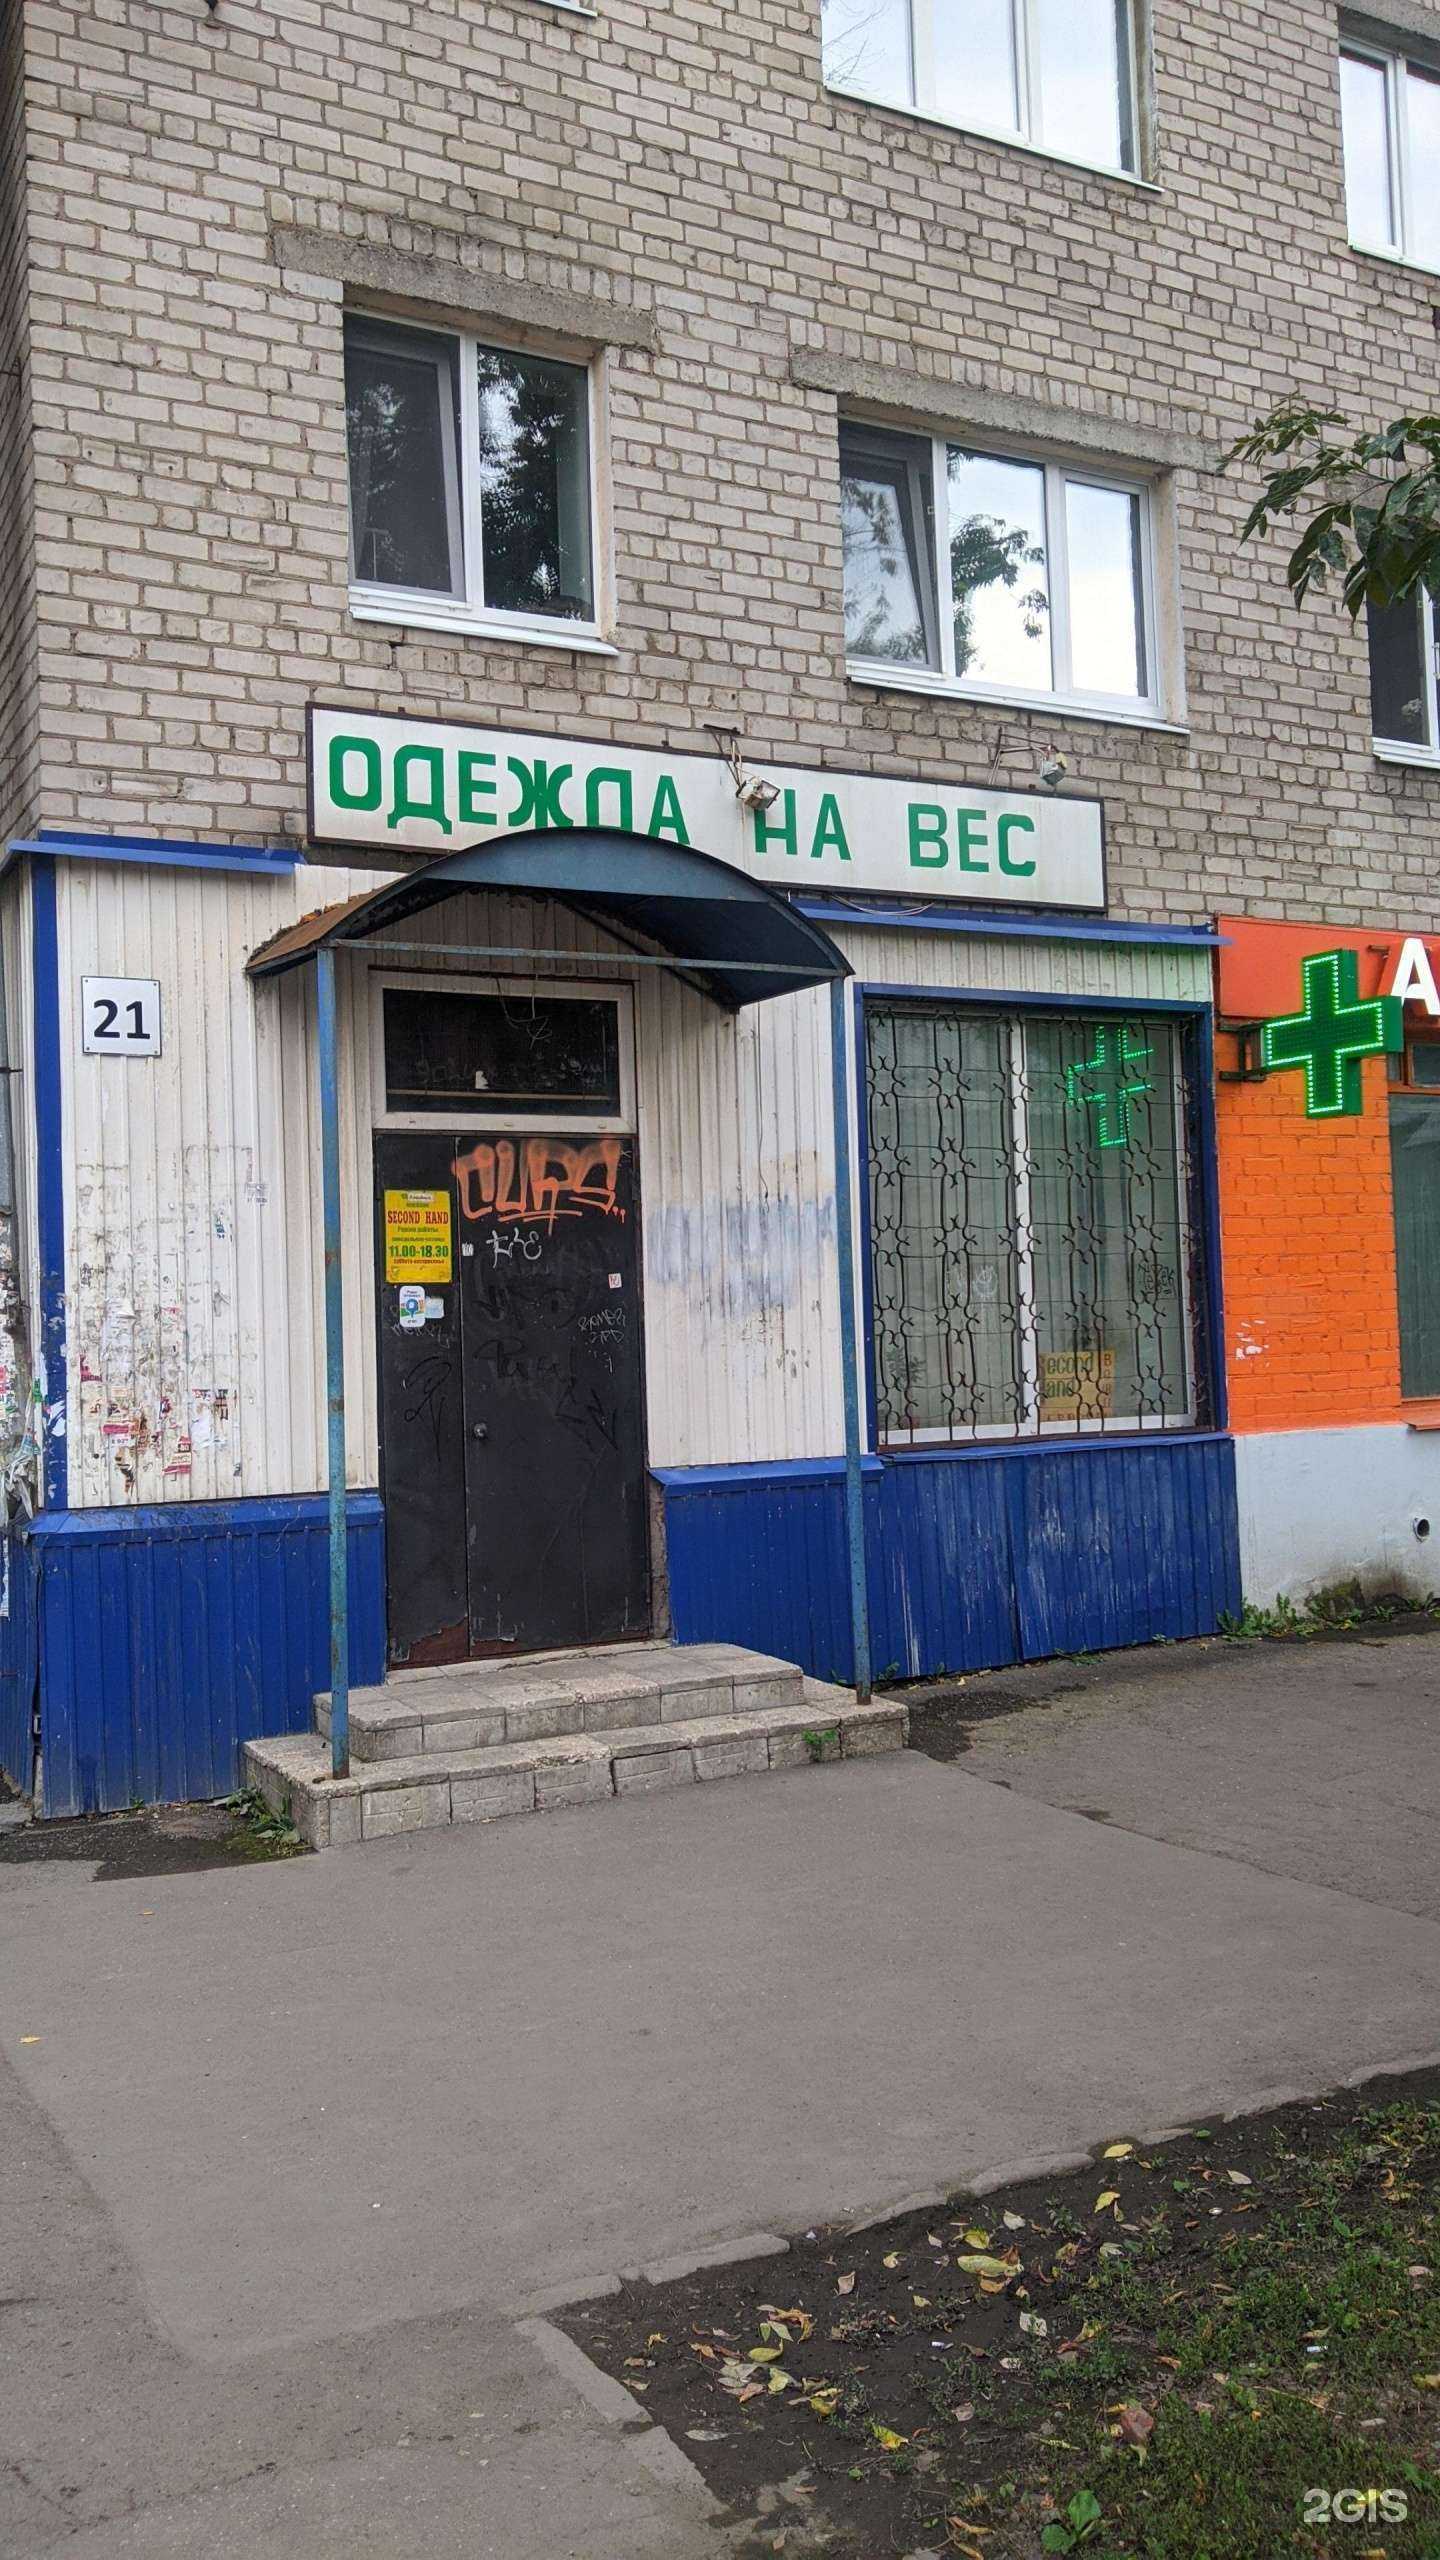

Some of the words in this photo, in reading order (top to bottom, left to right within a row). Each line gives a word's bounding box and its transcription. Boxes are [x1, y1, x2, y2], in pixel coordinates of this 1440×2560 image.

[328, 734, 691, 846] ОДЕЖДА
[754, 788, 851, 861] НА
[907, 802, 1038, 878] ВЕС
[93, 999, 151, 1040] 21
[387, 1210, 420, 1224] SECOND
[425, 1211, 449, 1225] HAND
[389, 1245, 449, 1258] 11.00-18.30
